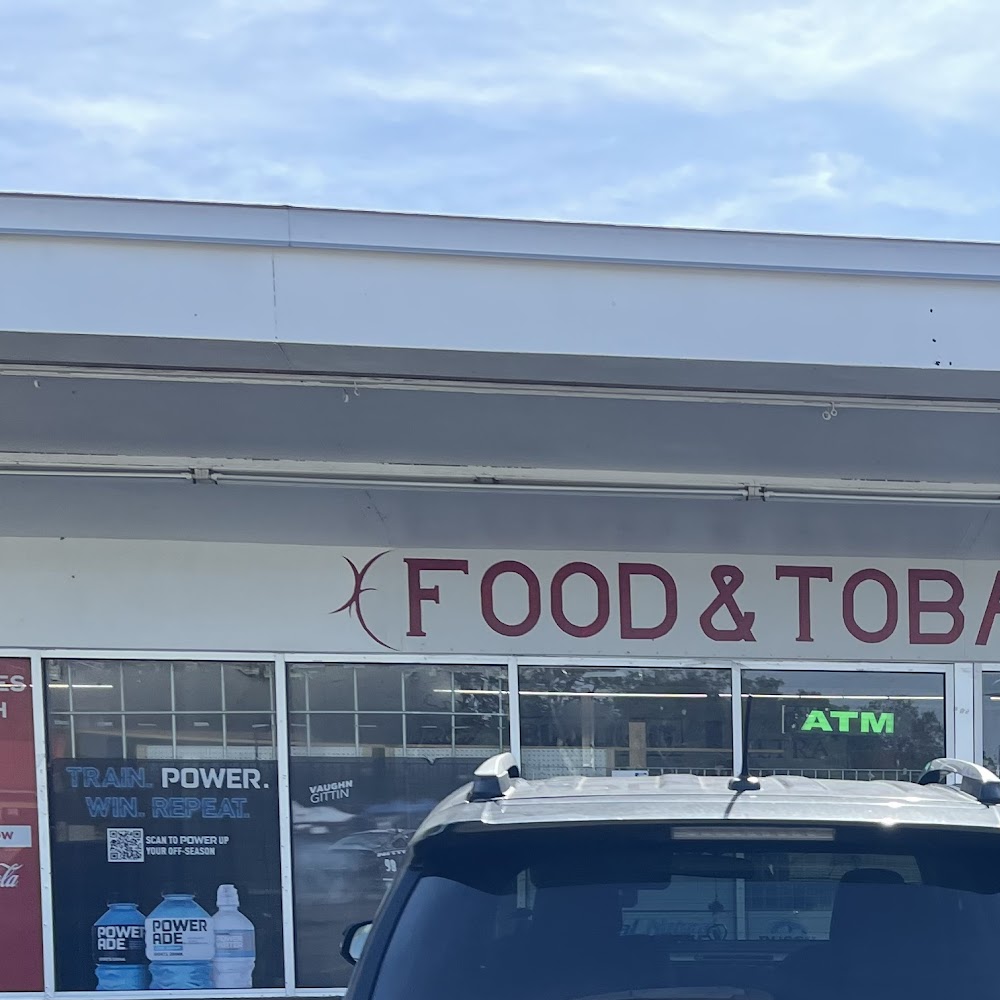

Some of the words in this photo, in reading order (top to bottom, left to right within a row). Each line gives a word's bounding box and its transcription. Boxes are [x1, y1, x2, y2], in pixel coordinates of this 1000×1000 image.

[403, 558, 678, 640] FOOD
[699, 564, 757, 641] &
[801, 710, 895, 734] ATM
[65, 767, 153, 788] TRAIN.
[161, 767, 270, 789] POWER.
[309, 780, 353, 794] VAUGHN
[310, 789, 350, 803] GITTIN
[85, 797, 145, 818] WIN.
[152, 798, 250, 819] REPEAT.
[146, 836, 167, 845] SCAN
[169, 836, 178, 845] TO
[180, 836, 217, 844] POWER
[219, 836, 229, 844] UP
[146, 847, 167, 855] YOUR
[168, 847, 215, 855] OFF-SEASON
[152, 919, 208, 932] POWER
[97, 938, 127, 950] ADE
[152, 932, 183, 945] ADE
